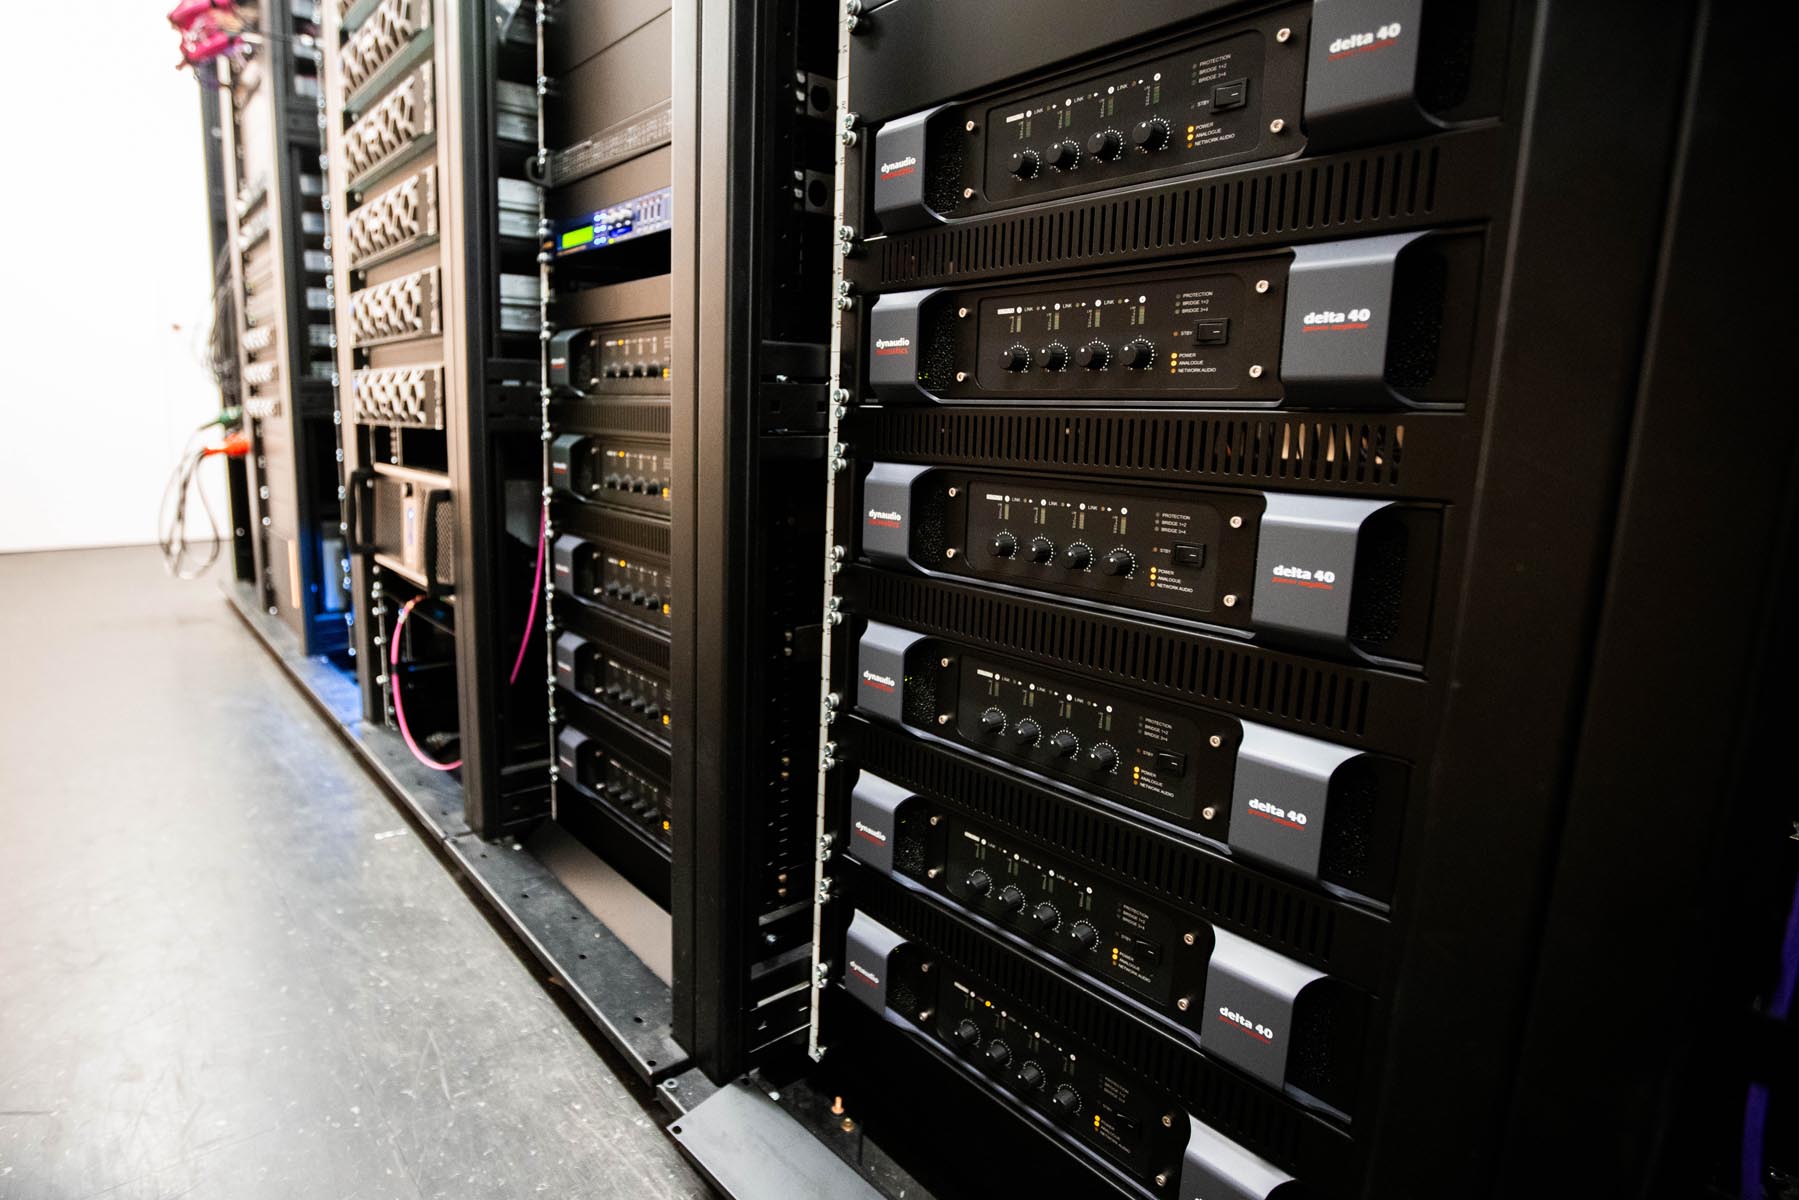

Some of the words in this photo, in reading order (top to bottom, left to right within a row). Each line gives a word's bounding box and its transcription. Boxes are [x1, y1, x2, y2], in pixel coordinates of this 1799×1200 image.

[1329, 32, 1375, 54] delta
[1376, 22, 1402, 40] 40
[1199, 53, 1232, 67] PROTECTION
[1199, 66, 1217, 75] BRIDGE
[1198, 74, 1217, 83] BRIDGE
[1116, 83, 1129, 92] LINK
[1073, 96, 1085, 104] LINK
[1033, 107, 1044, 115] LINK
[1195, 121, 1215, 131] POWER
[1195, 128, 1222, 139] ANALOGUE
[1194, 136, 1219, 147] NETWORK
[1219, 133, 1236, 142] AUDIO
[880, 156, 917, 174] dynaudio
[1182, 291, 1214, 299] PROTECTION
[1303, 310, 1346, 325] delta
[1347, 308, 1371, 322] 40
[876, 337, 911, 350] dynaudio
[868, 508, 902, 522] dynaudio
[1161, 512, 1192, 521] PROTECTION
[1157, 568, 1175, 576] POWER
[1272, 564, 1312, 581] delta
[1313, 569, 1336, 584] 40
[1157, 576, 1182, 585] ANALOGUE
[1156, 583, 1179, 591] NETWORK
[862, 669, 896, 687] dynaudio
[1248, 797, 1285, 819] delta
[1287, 809, 1308, 825] 40
[1219, 1006, 1254, 1031] delta
[1255, 1023, 1274, 1040] 40
